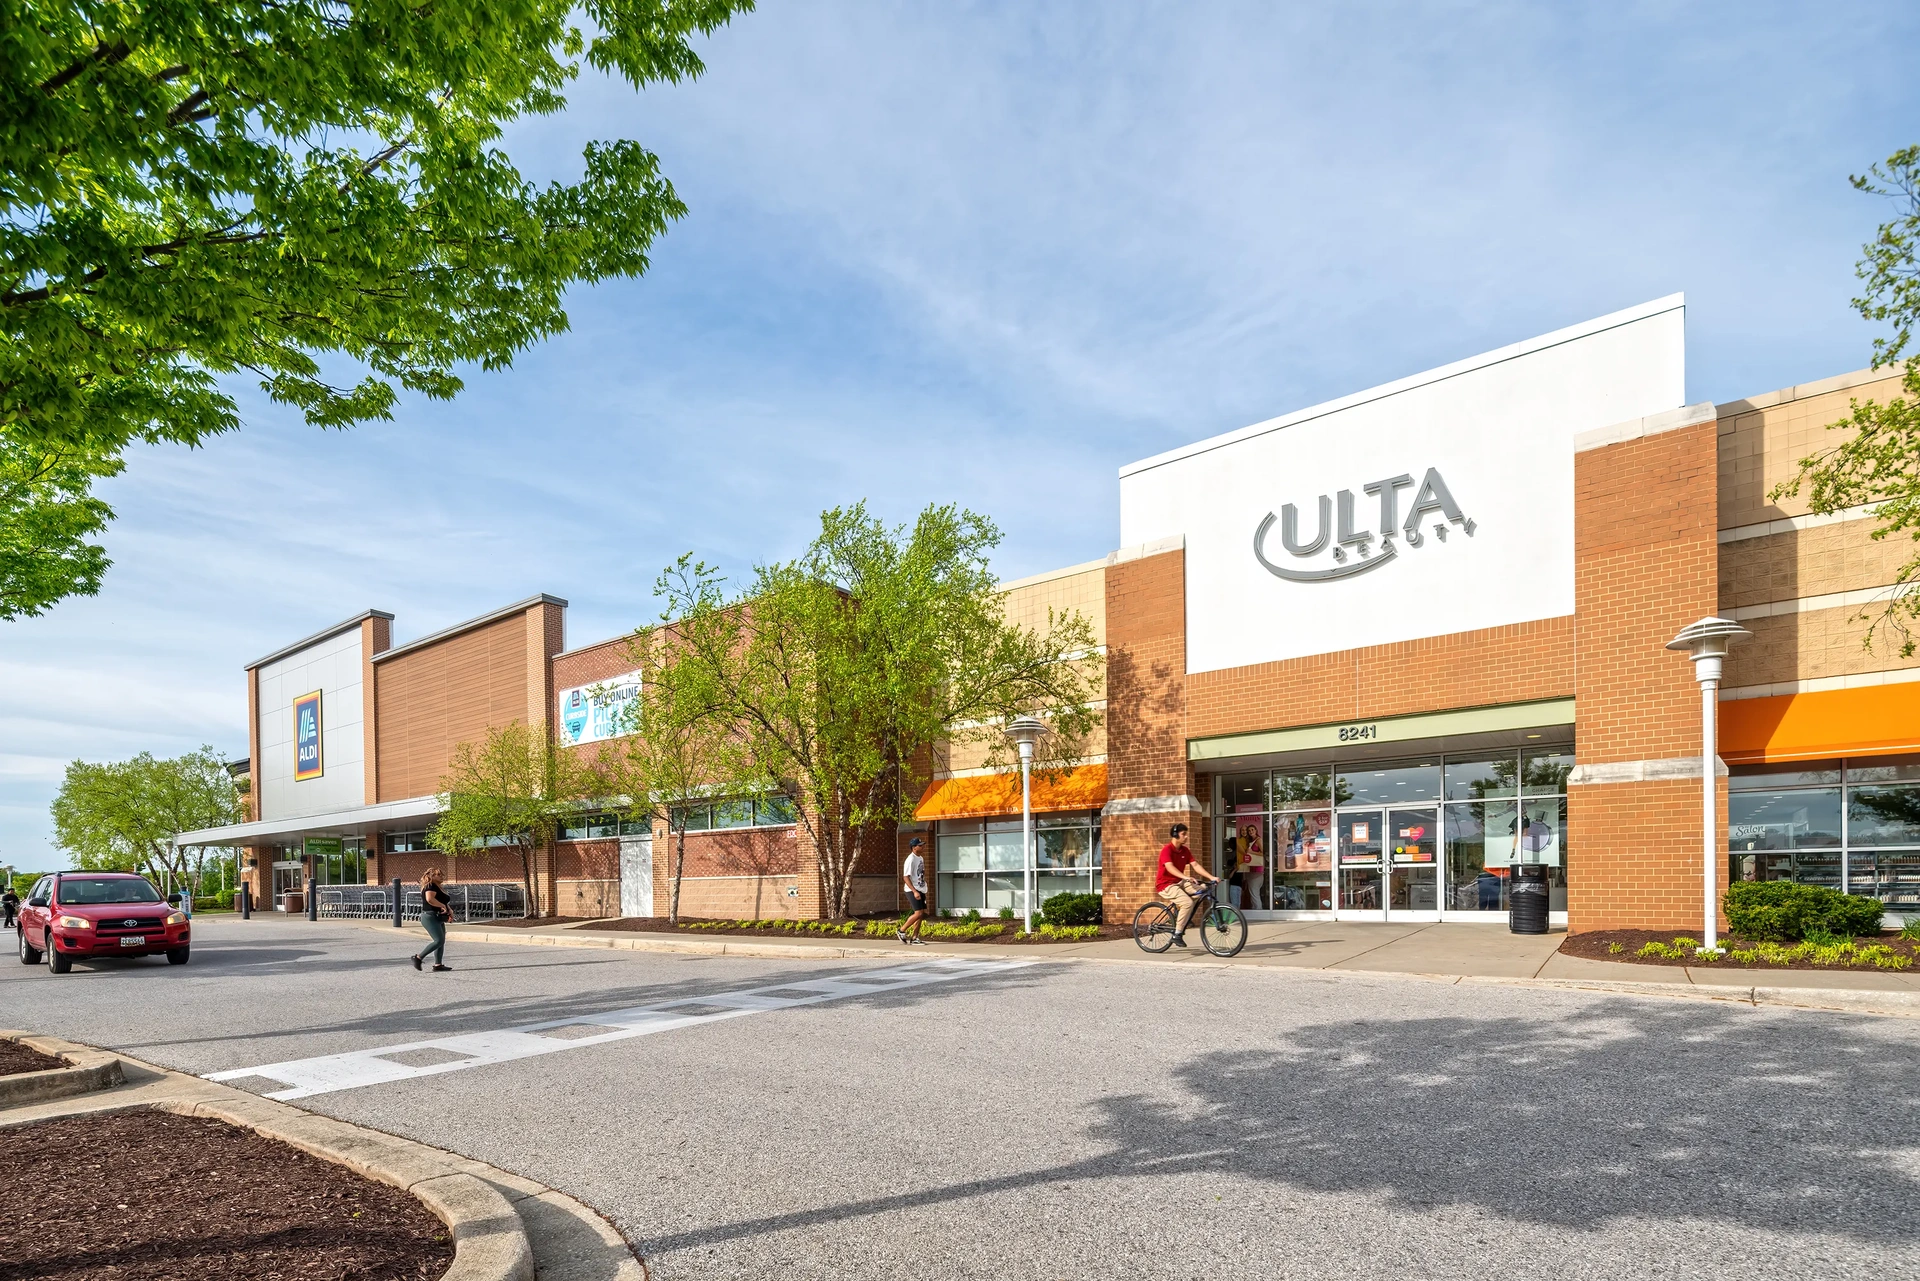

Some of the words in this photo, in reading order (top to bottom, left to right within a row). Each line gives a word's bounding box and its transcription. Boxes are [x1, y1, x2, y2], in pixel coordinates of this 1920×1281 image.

[1281, 467, 1464, 555] ULTA
[1332, 516, 1477, 562] BEAUTY
[593, 693, 609, 706] BUY
[610, 686, 639, 702] ONLINE
[1338, 725, 1377, 741] 8241
[299, 744, 318, 761] ALDI
[1735, 825, 1766, 837] Salon
